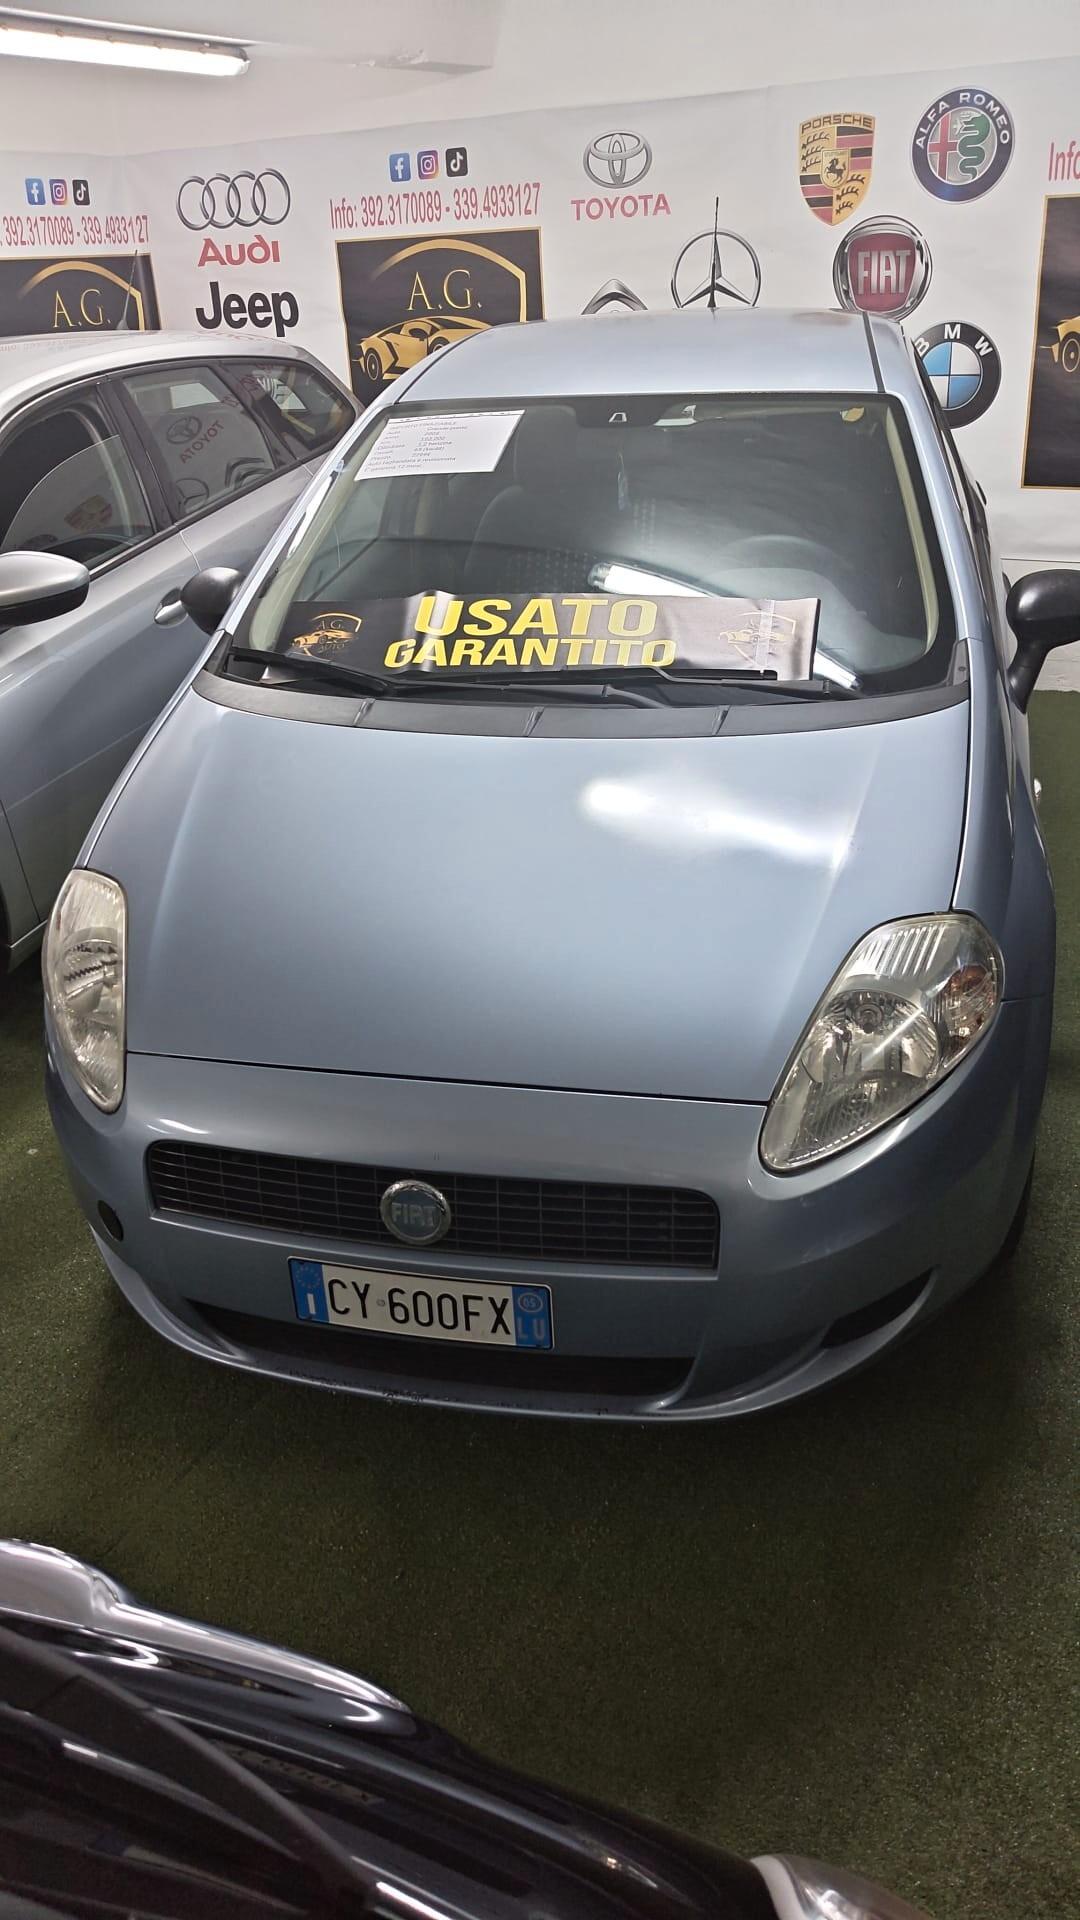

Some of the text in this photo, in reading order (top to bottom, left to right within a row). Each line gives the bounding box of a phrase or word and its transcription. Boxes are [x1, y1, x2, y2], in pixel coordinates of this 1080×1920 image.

[801, 114, 873, 134] PORSCHE
[915, 92, 1010, 149] ALFA ROMEO
[329, 197, 358, 230] Info:
[360, 190, 442, 227] 392.3170089
[453, 182, 541, 221] 339.4933127
[571, 194, 672, 221] TOYOTA
[2, 215, 75, 246] 392.3170089
[81, 214, 149, 245] 339.4933127
[198, 234, 280, 267] Audi
[407, 269, 482, 311] A.G.
[857, 249, 911, 295] FIAT
[53, 288, 111, 328] A.G.
[196, 281, 299, 337] Jeep
[414, 596, 658, 636] USATO
[384, 638, 676, 668] GARANTITO
[391, 1202, 437, 1227] FIAT
[306, 1293, 316, 1315] I
[328, 1279, 370, 1319] CY
[387, 1288, 511, 1335] 600FX
